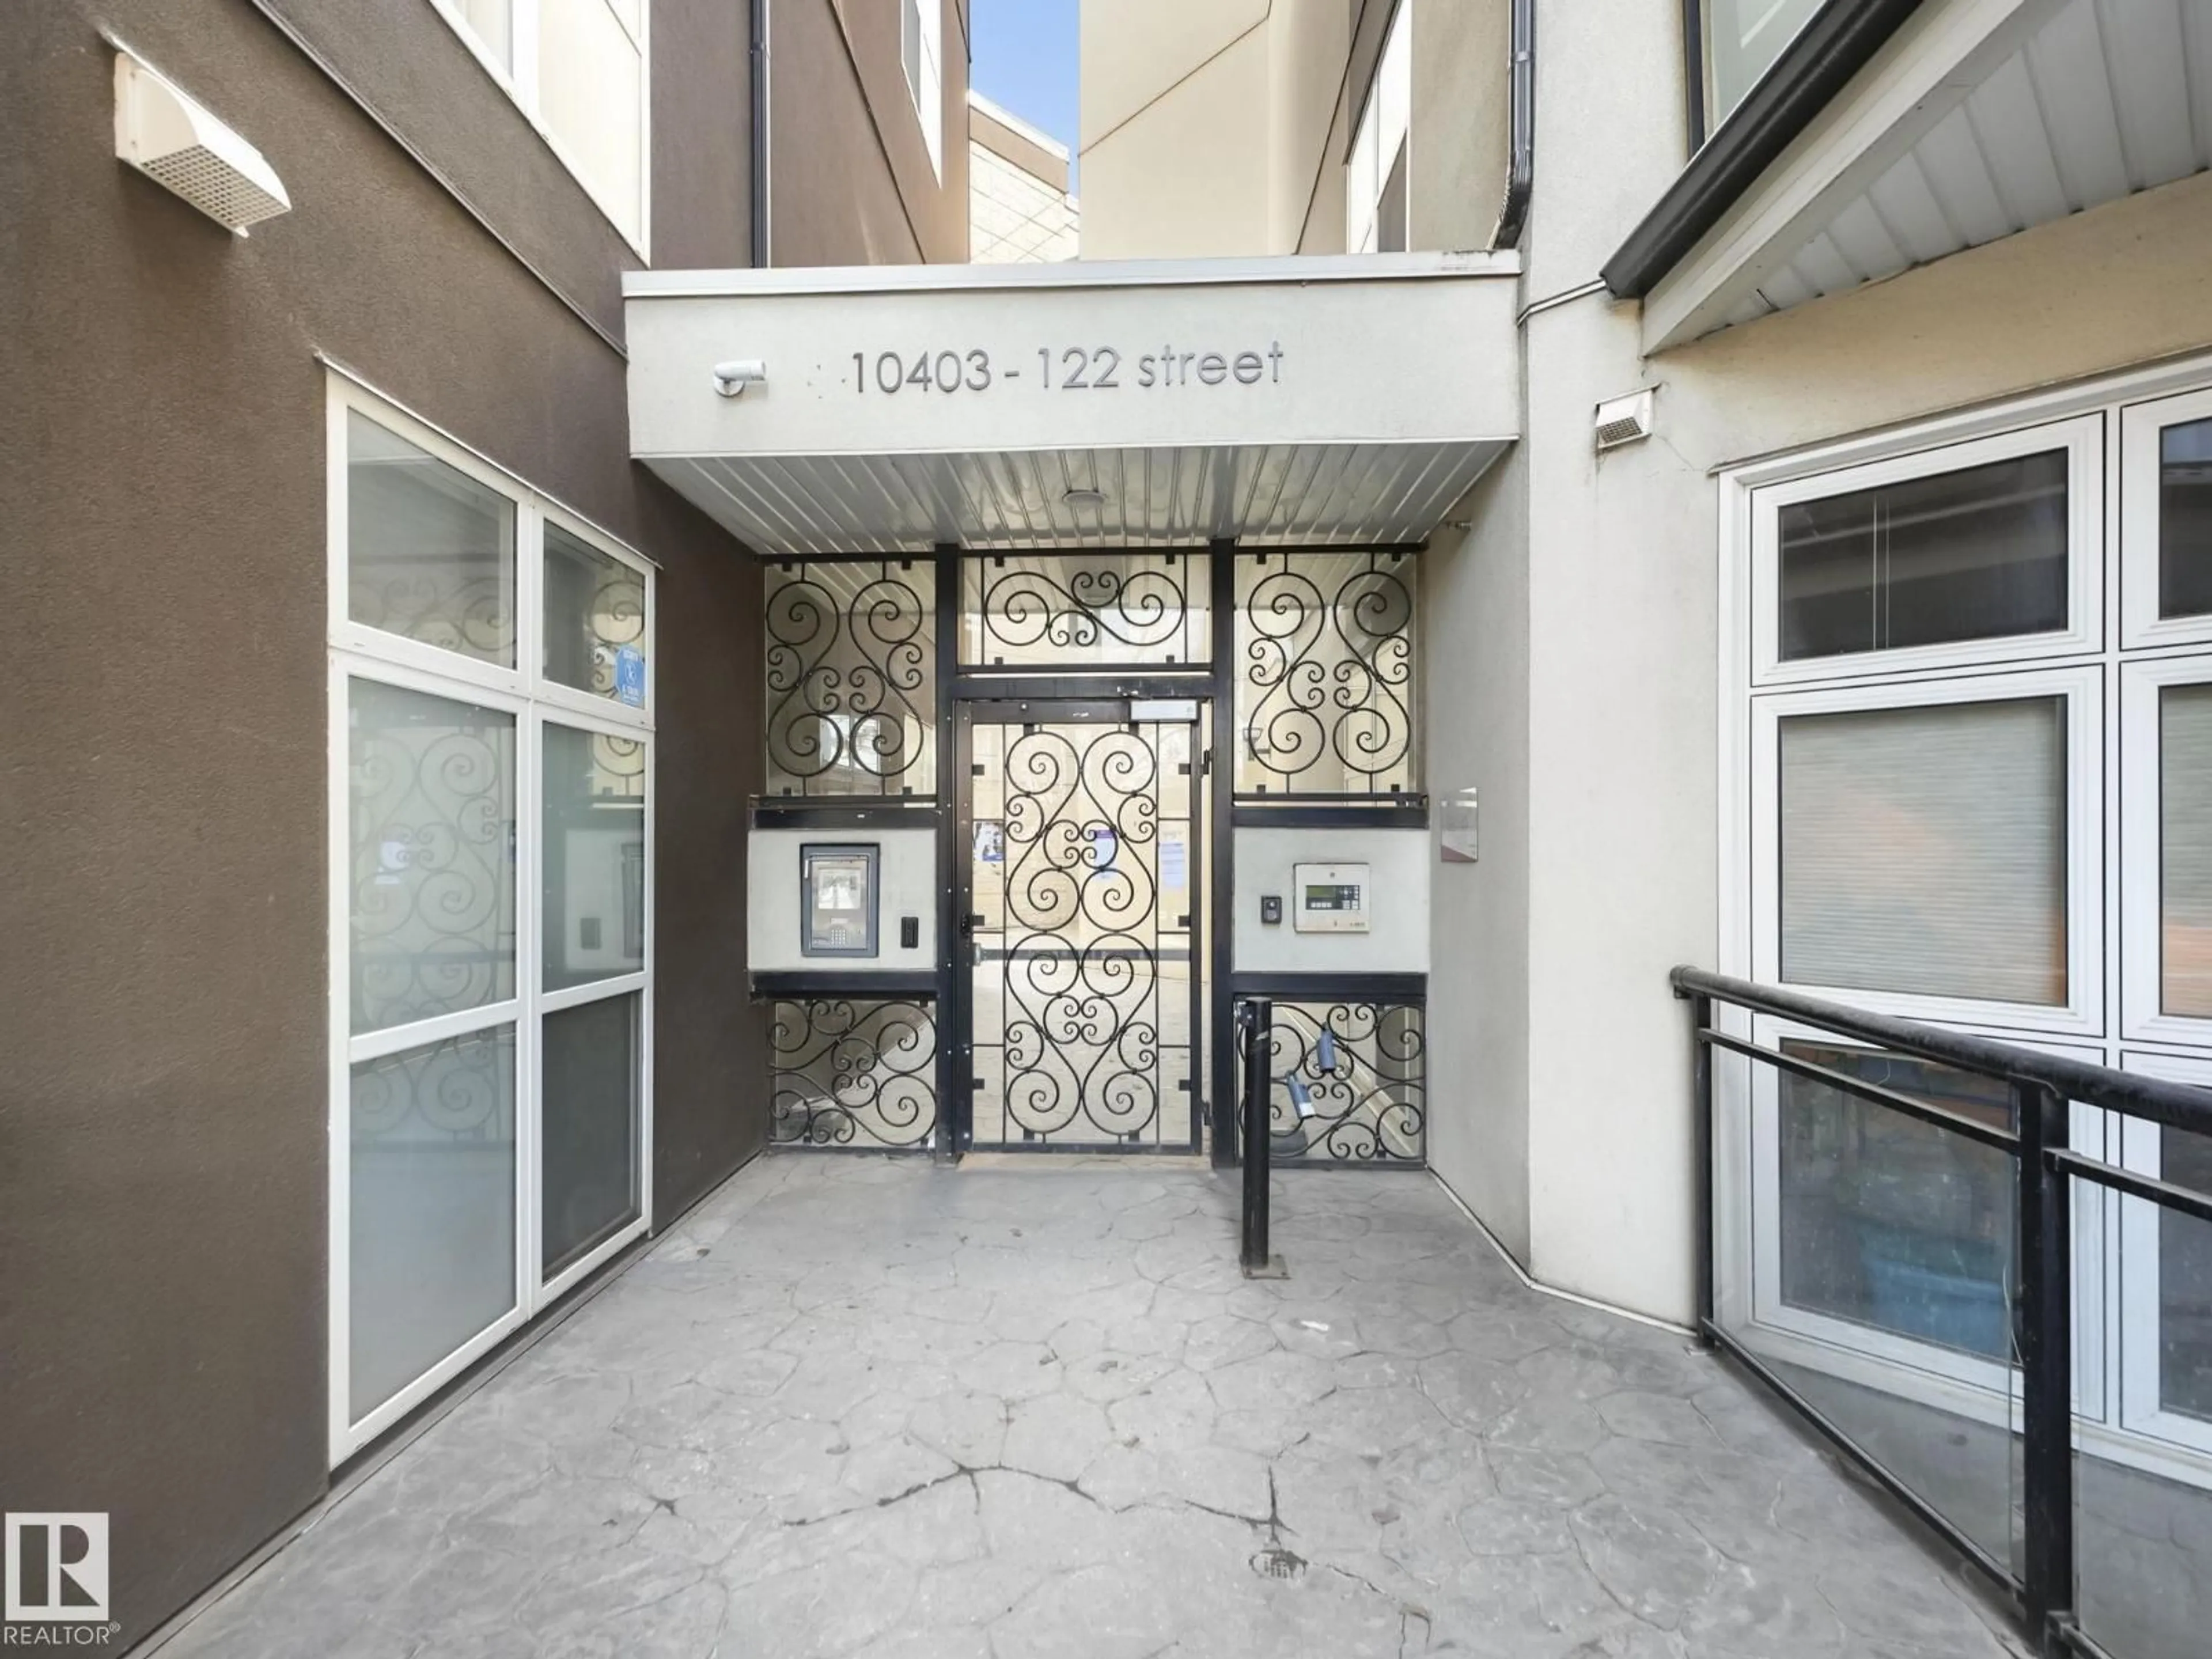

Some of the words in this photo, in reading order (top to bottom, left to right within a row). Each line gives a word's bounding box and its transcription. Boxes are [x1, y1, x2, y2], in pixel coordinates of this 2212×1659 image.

[853, 349, 992, 394] 10403
[1037, 345, 1120, 389] 122
[1137, 340, 1284, 387] street
